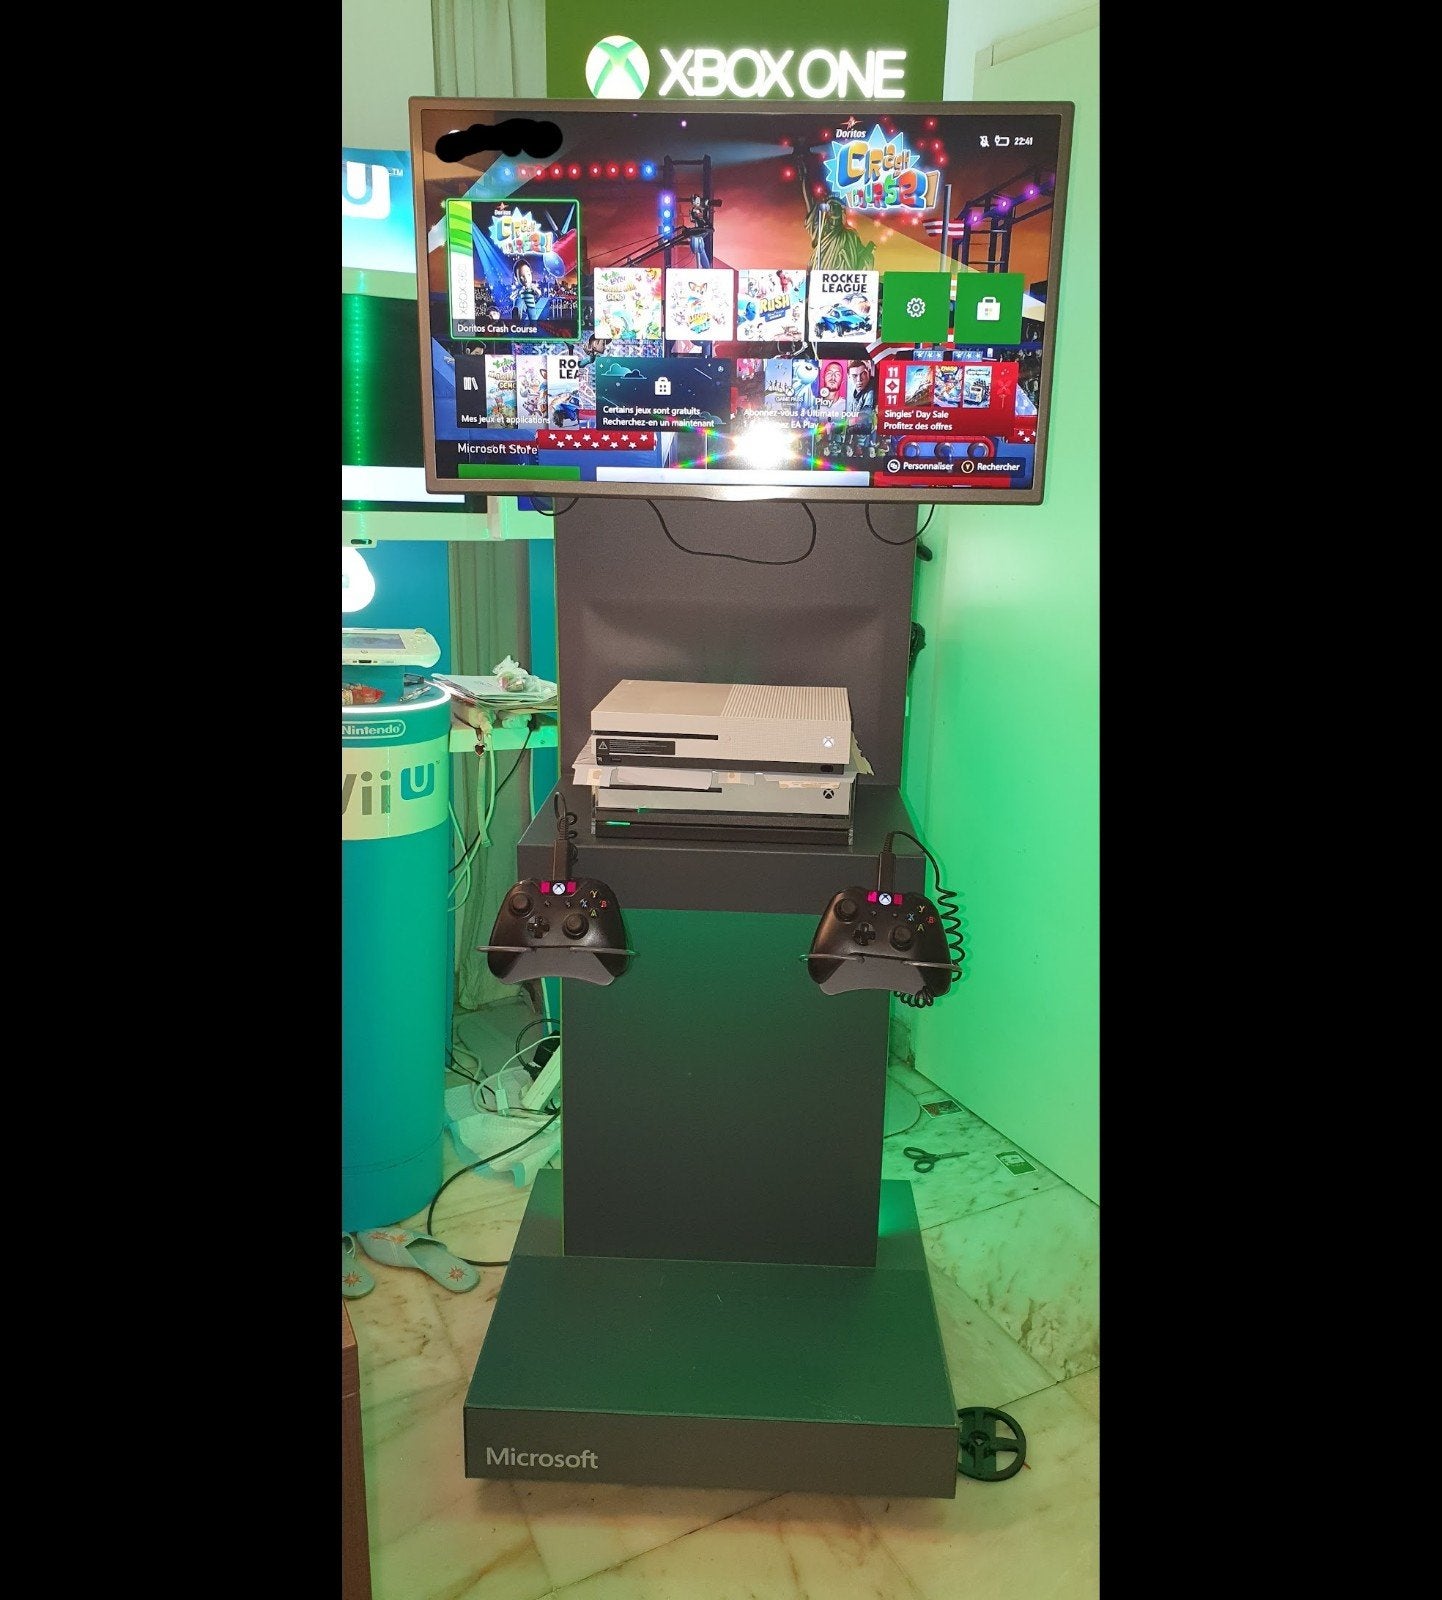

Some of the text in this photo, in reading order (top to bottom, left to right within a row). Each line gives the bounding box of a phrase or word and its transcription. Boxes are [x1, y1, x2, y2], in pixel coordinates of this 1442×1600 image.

[659, 47, 907, 100] XBOX ONE
[835, 128, 867, 139] Doritos
[1013, 136, 1034, 146] 22:41
[822, 273, 868, 284] ROCKET
[822, 283, 868, 293] LEAGUE
[457, 324, 538, 334] Doritos Crash Course
[815, 398, 834, 407] Play
[602, 405, 701, 417] Certains jeux sont gratuits
[807, 410, 839, 418] Ultimate
[841, 411, 860, 419] pour
[916, 410, 931, 421] Day
[932, 410, 949, 419] Sale
[461, 414, 478, 423] Mes
[478, 415, 495, 425] jeux
[506, 416, 551, 425] applications
[602, 417, 658, 427] Recherchez-en
[671, 419, 715, 428] maintenant
[803, 420, 819, 430] Play
[883, 421, 953, 431] Profitez des offres
[457, 442, 538, 455] Microsoft Store
[902, 461, 954, 471] Personnaliser
[977, 462, 1020, 471] Rechercher
[342, 725, 400, 736] Nintendo
[486, 1446, 599, 1470] Microsoft
